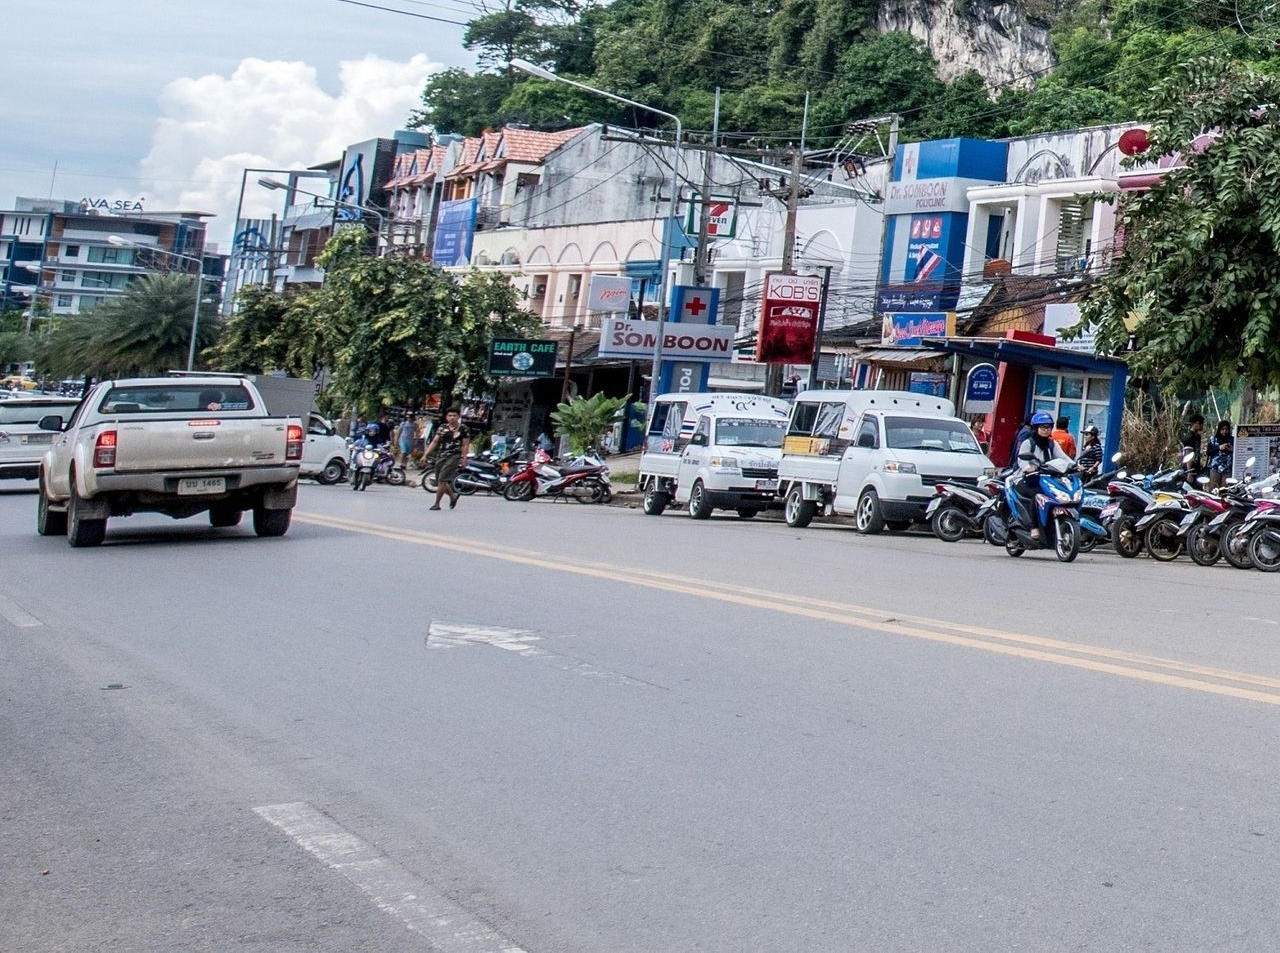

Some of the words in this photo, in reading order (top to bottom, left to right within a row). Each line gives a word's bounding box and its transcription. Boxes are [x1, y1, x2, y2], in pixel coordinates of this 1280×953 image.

[903, 182, 948, 199] SOMBOON
[79, 198, 109, 209] AVA
[114, 200, 144, 211] SEA
[916, 198, 946, 207] POLYCLINIC
[770, 285, 818, 300] KOB'S
[614, 322, 633, 331] Dr.
[493, 342, 526, 351] EARTH
[530, 343, 556, 353] CAFÉ
[612, 332, 730, 352] SOMBOON
